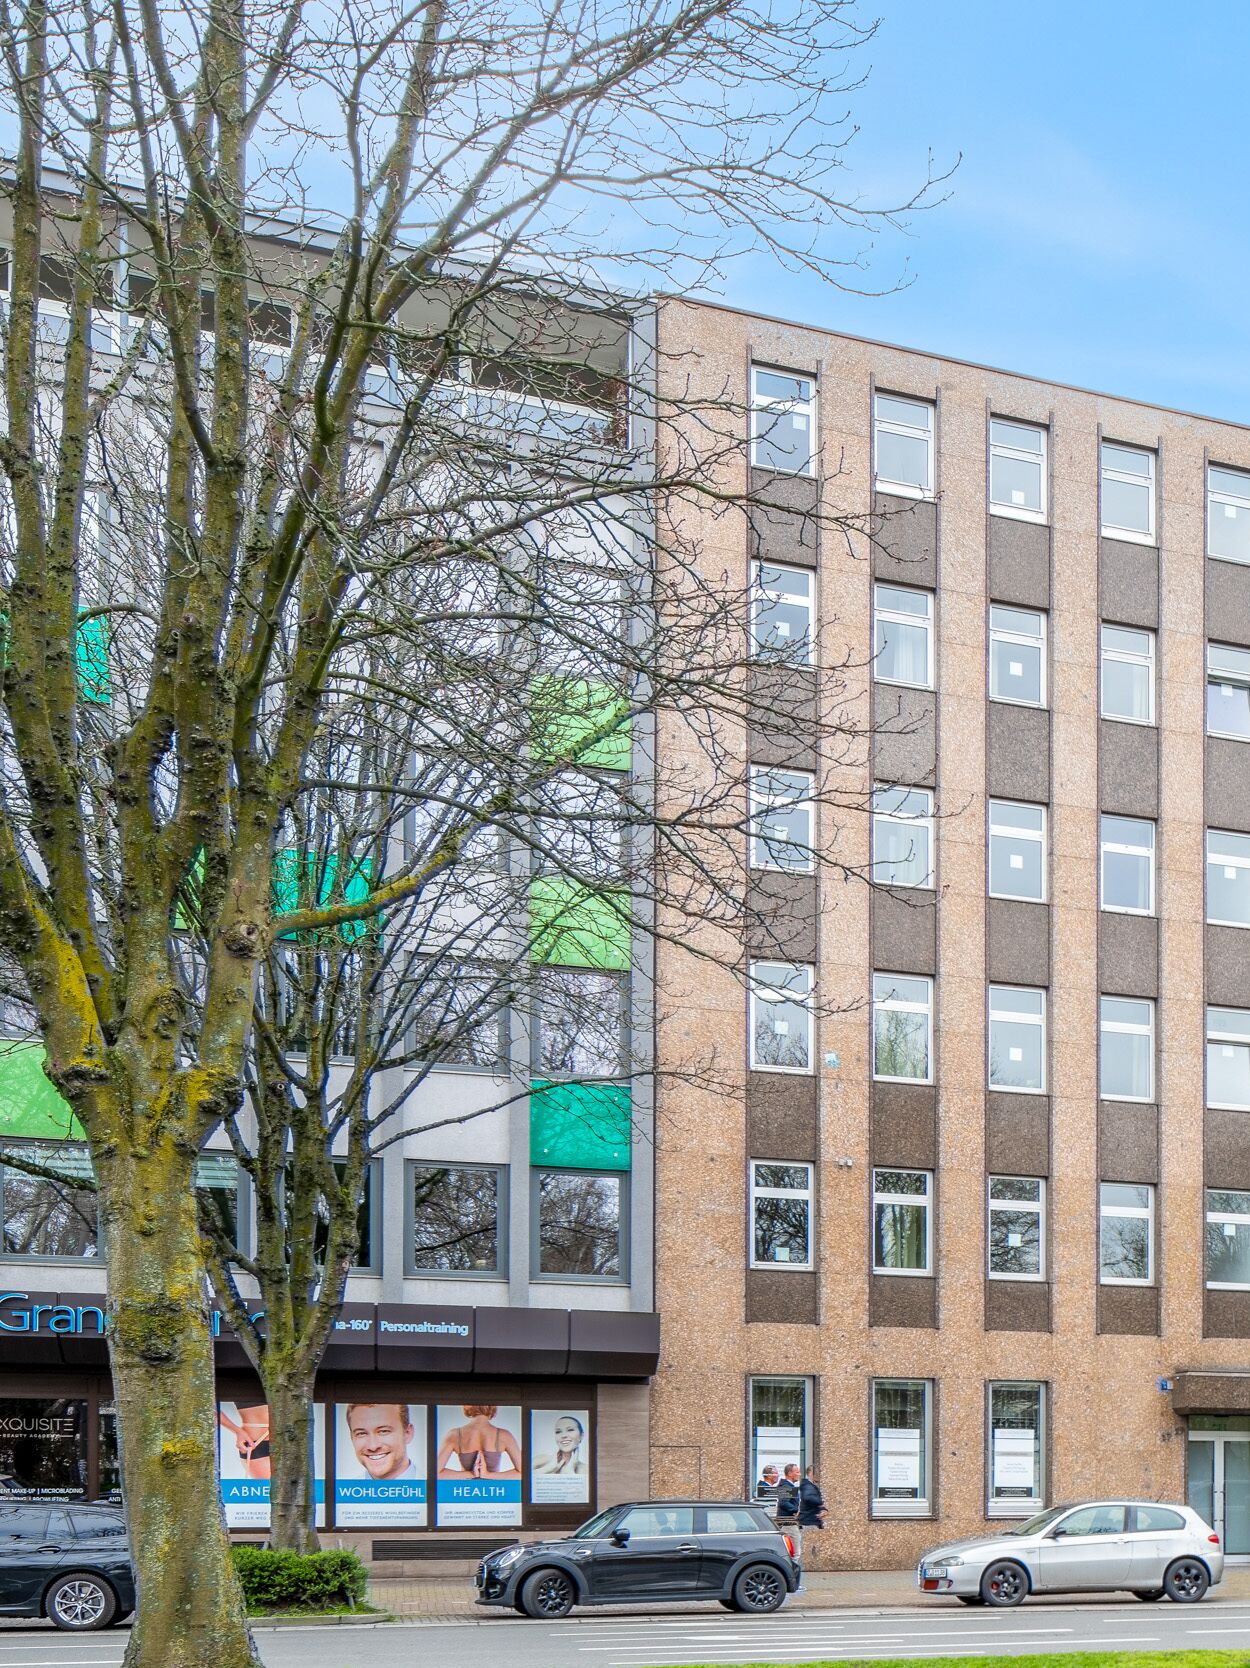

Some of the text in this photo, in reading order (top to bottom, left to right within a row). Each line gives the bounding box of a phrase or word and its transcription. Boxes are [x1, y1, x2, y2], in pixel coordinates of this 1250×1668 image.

[0, 1292, 109, 1334] Gran
[380, 1320, 469, 1336] Personaltraining
[339, 1485, 425, 1498] WOHLGEFÜHL
[453, 1486, 505, 1497] HEALTH
